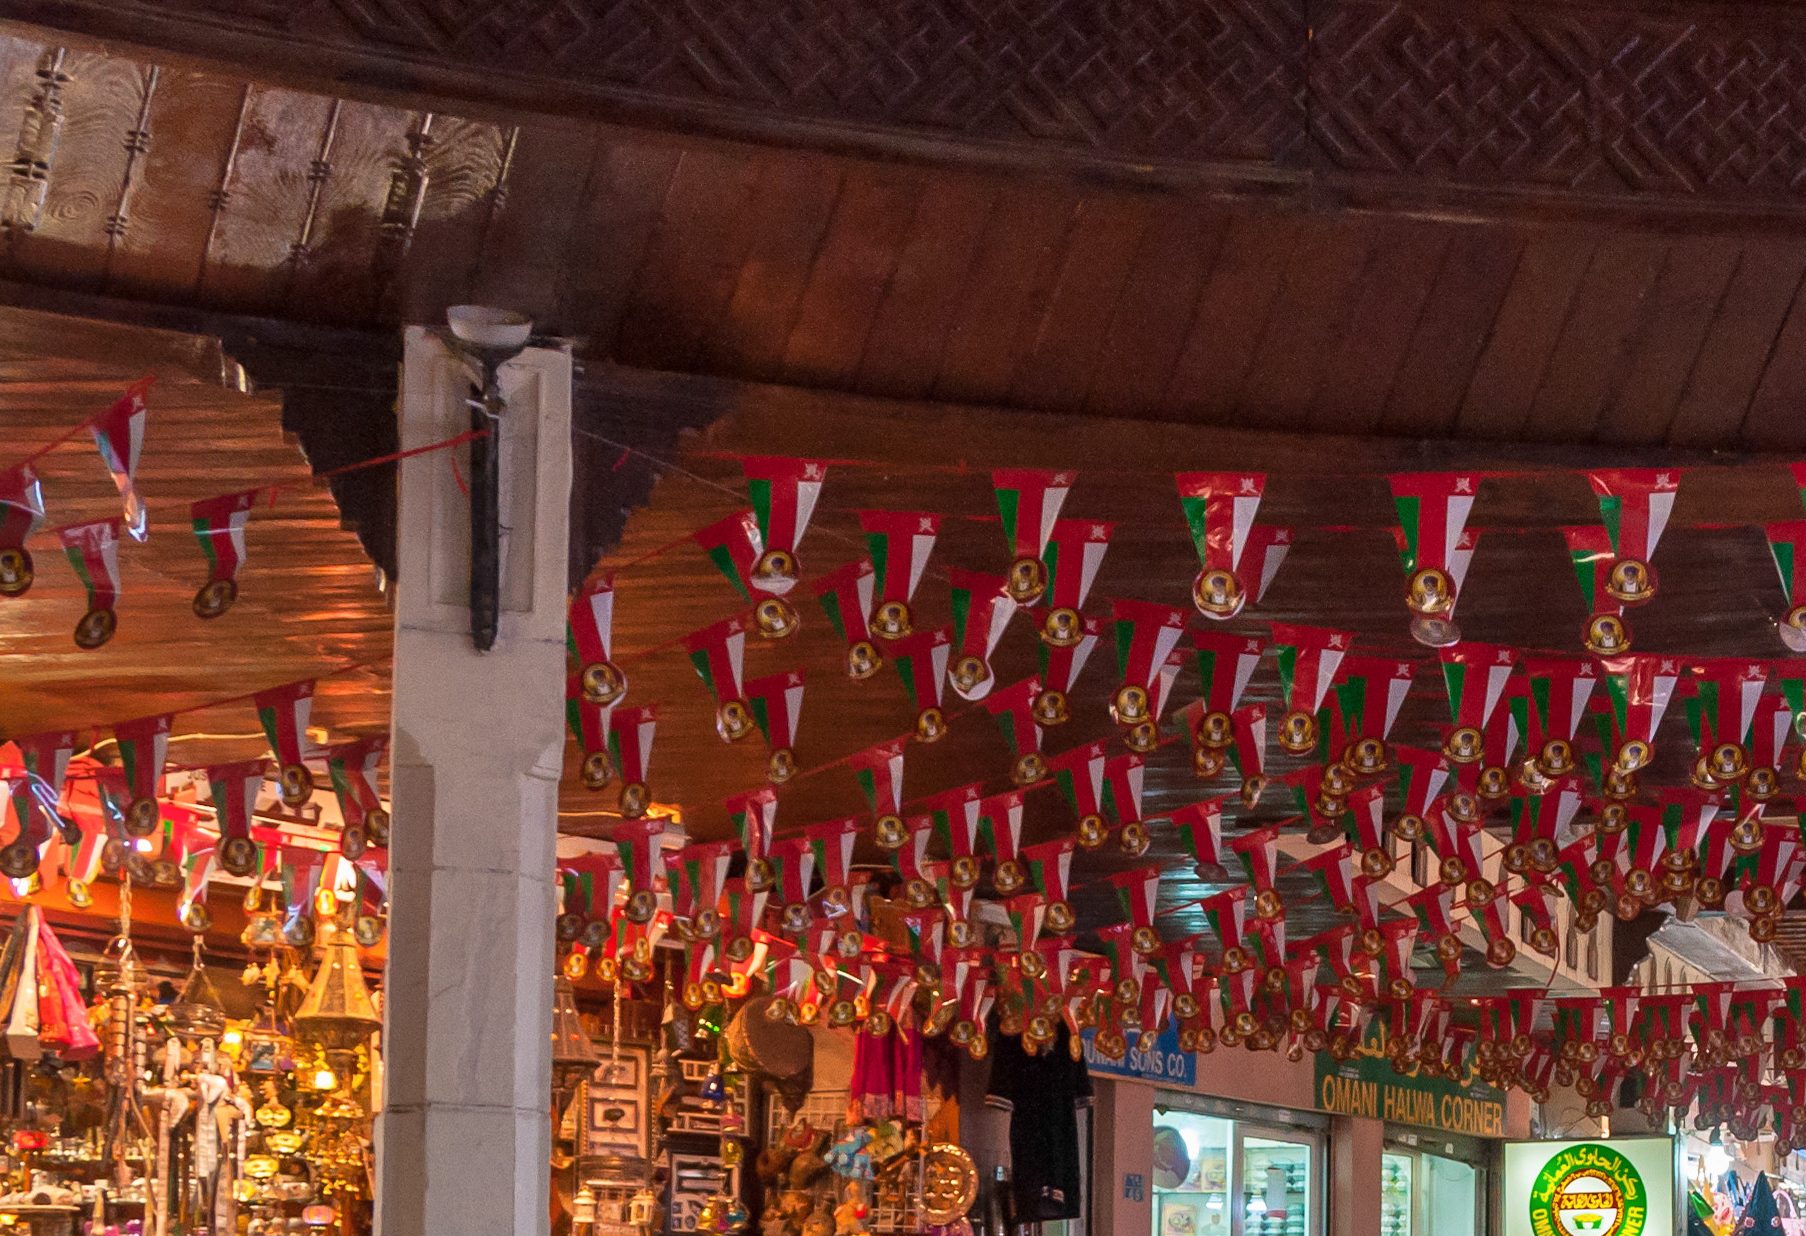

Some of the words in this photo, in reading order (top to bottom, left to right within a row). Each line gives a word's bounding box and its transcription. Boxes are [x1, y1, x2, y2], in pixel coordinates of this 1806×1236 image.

[1322, 1075, 1378, 1118] OMANI
[1383, 1084, 1437, 1128] HALWA
[1441, 1094, 1505, 1137] CORNER
